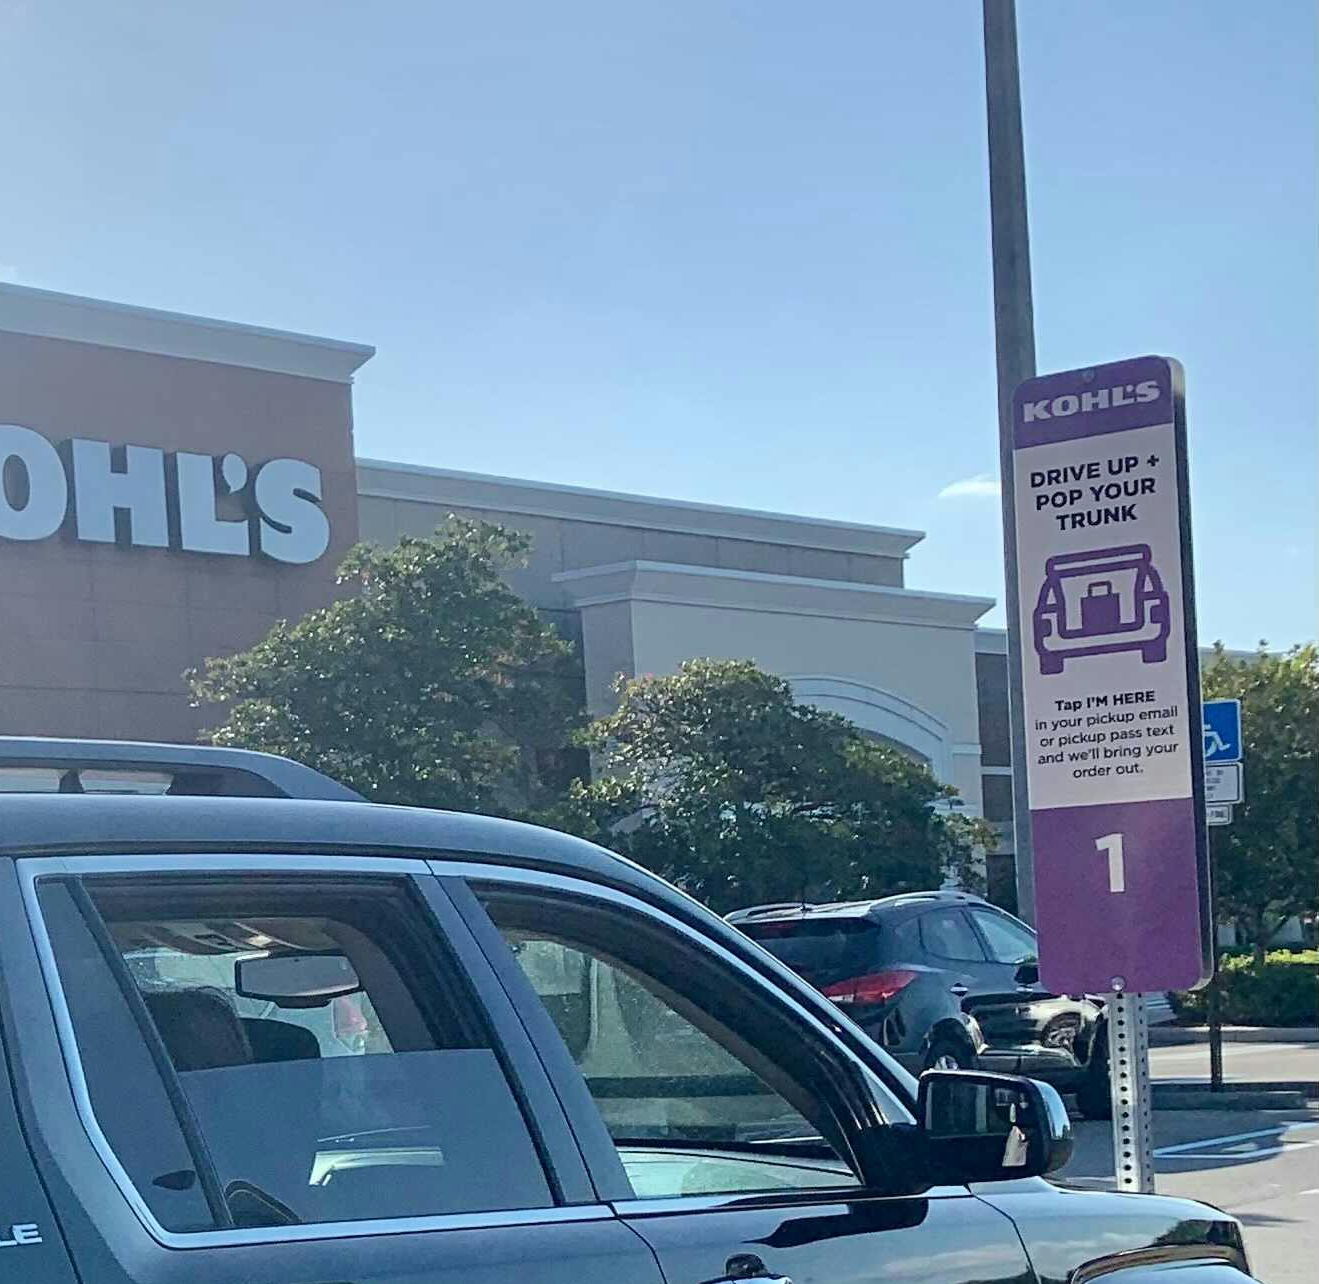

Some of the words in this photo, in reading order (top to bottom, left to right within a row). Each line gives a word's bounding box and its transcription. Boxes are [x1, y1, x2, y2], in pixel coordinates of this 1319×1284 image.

[1023, 381, 1161, 423] KOHL'S
[1030, 462, 1101, 489] DRIVE
[1107, 456, 1139, 477] UP
[1035, 488, 1084, 511] POP
[1089, 477, 1157, 503] YOUR
[1056, 503, 1138, 531] TRUNK
[1054, 700, 1083, 712] Tap
[1086, 695, 1108, 709] I'M
[1112, 690, 1156, 706] HERE
[1035, 720, 1048, 731] in
[1051, 717, 1083, 732] your
[1086, 711, 1135, 727] pickup
[1138, 705, 1178, 721] email
[1039, 738, 1055, 748] or
[1058, 731, 1106, 748] pickup
[1109, 728, 1142, 743] pass
[1146, 724, 1175, 737] text
[1037, 751, 1065, 765] and
[1068, 747, 1100, 762] we'll
[1103, 744, 1142, 759] bring
[1145, 743, 1179, 757] your
[1073, 766, 1111, 779] order
[1115, 762, 1144, 775] out.
[1095, 833, 1126, 894] 1
